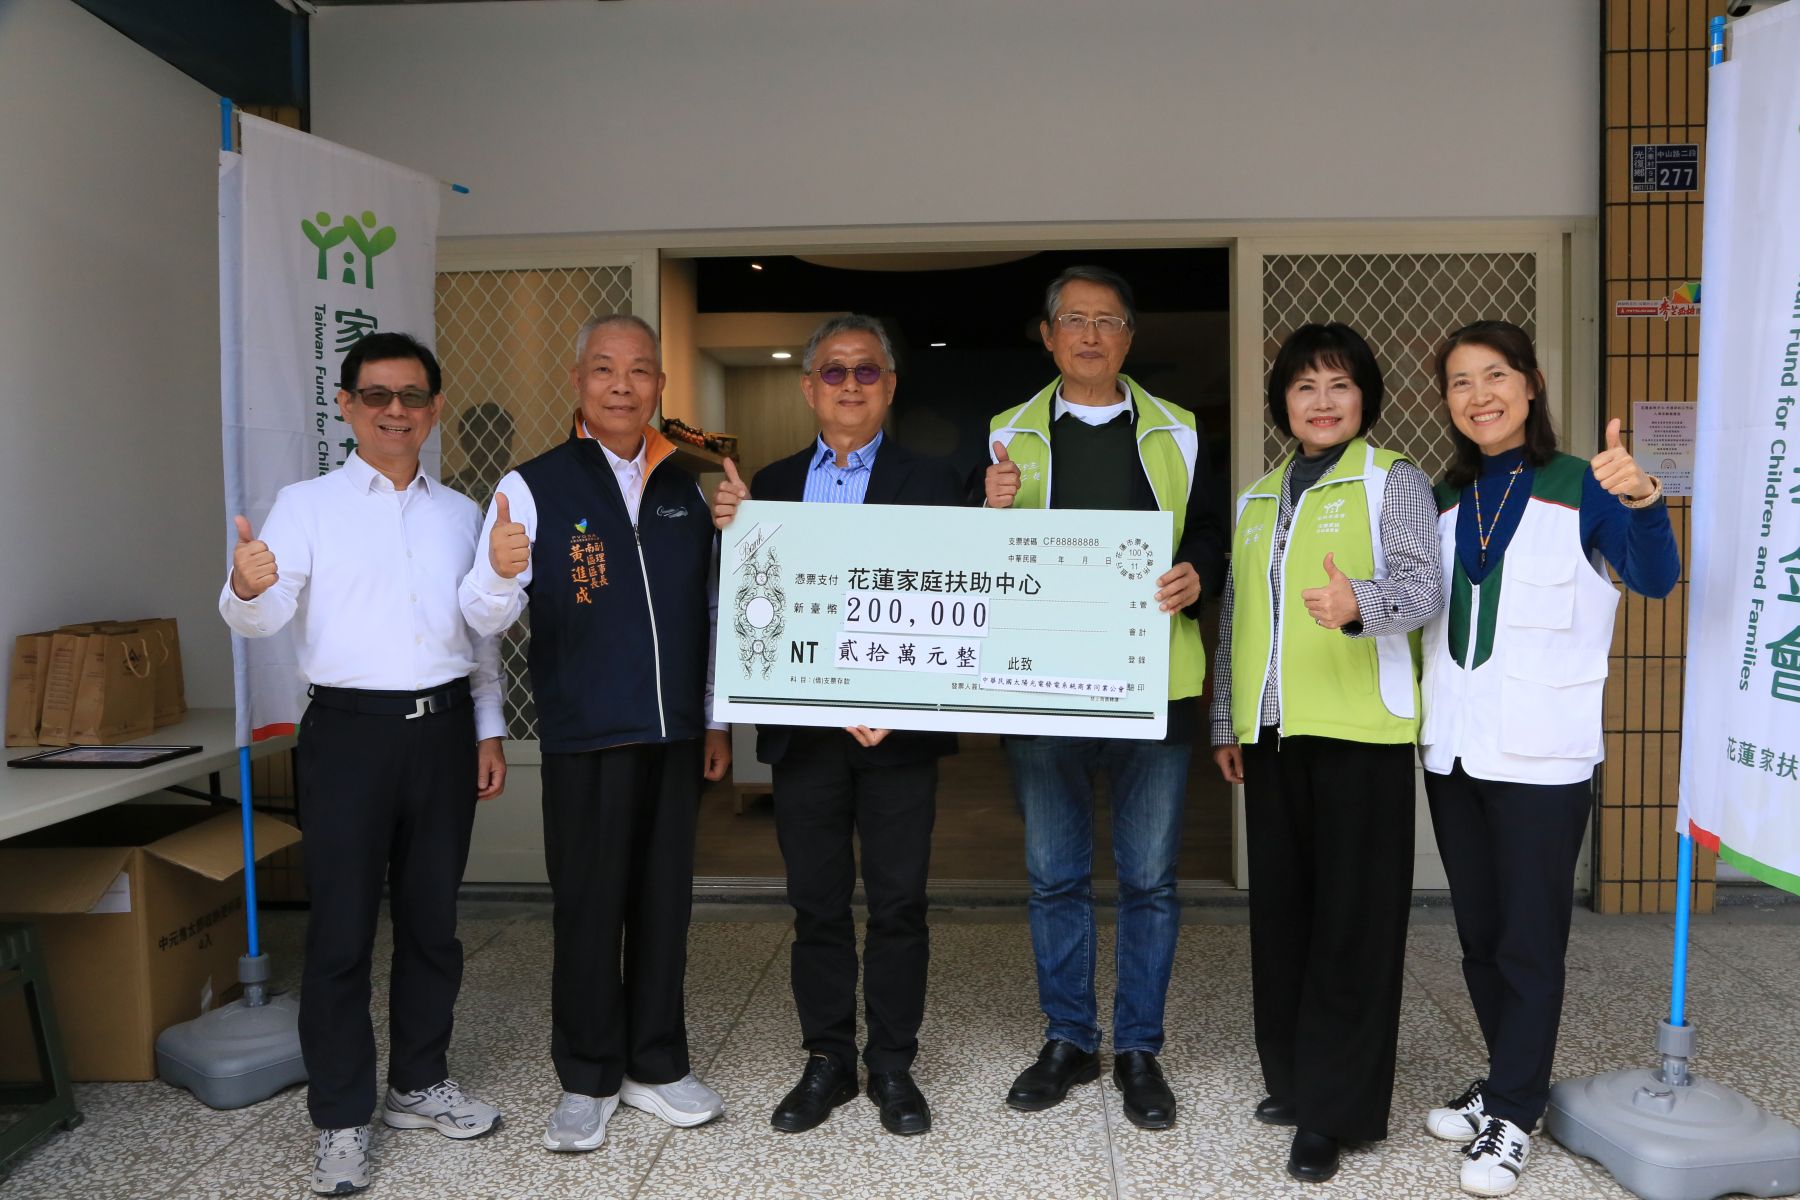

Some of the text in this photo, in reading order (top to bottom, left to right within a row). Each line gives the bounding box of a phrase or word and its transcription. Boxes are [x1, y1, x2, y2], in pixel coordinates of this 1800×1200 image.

[1660, 168, 1694, 186] 277
[314, 304, 327, 360] Taiwan
[315, 366, 328, 406] Fund
[316, 411, 328, 436] for
[1775, 395, 1796, 430] for
[1760, 439, 1787, 537] Children
[739, 528, 765, 561] Bank
[1043, 537, 1099, 547] CF88888888
[569, 543, 592, 604] 黃進成
[1008, 554, 1112, 565] 中華民國 年 月 日
[1753, 546, 1768, 590] and
[847, 567, 1041, 595] 花蓮家庭扶助中心
[846, 597, 987, 628] 200,000
[790, 638, 977, 668] NT 貳拾萬元整
[1739, 598, 1765, 691] Families
[1008, 656, 1033, 671] 此致
[1727, 735, 1799, 781] 花蓮家扶
